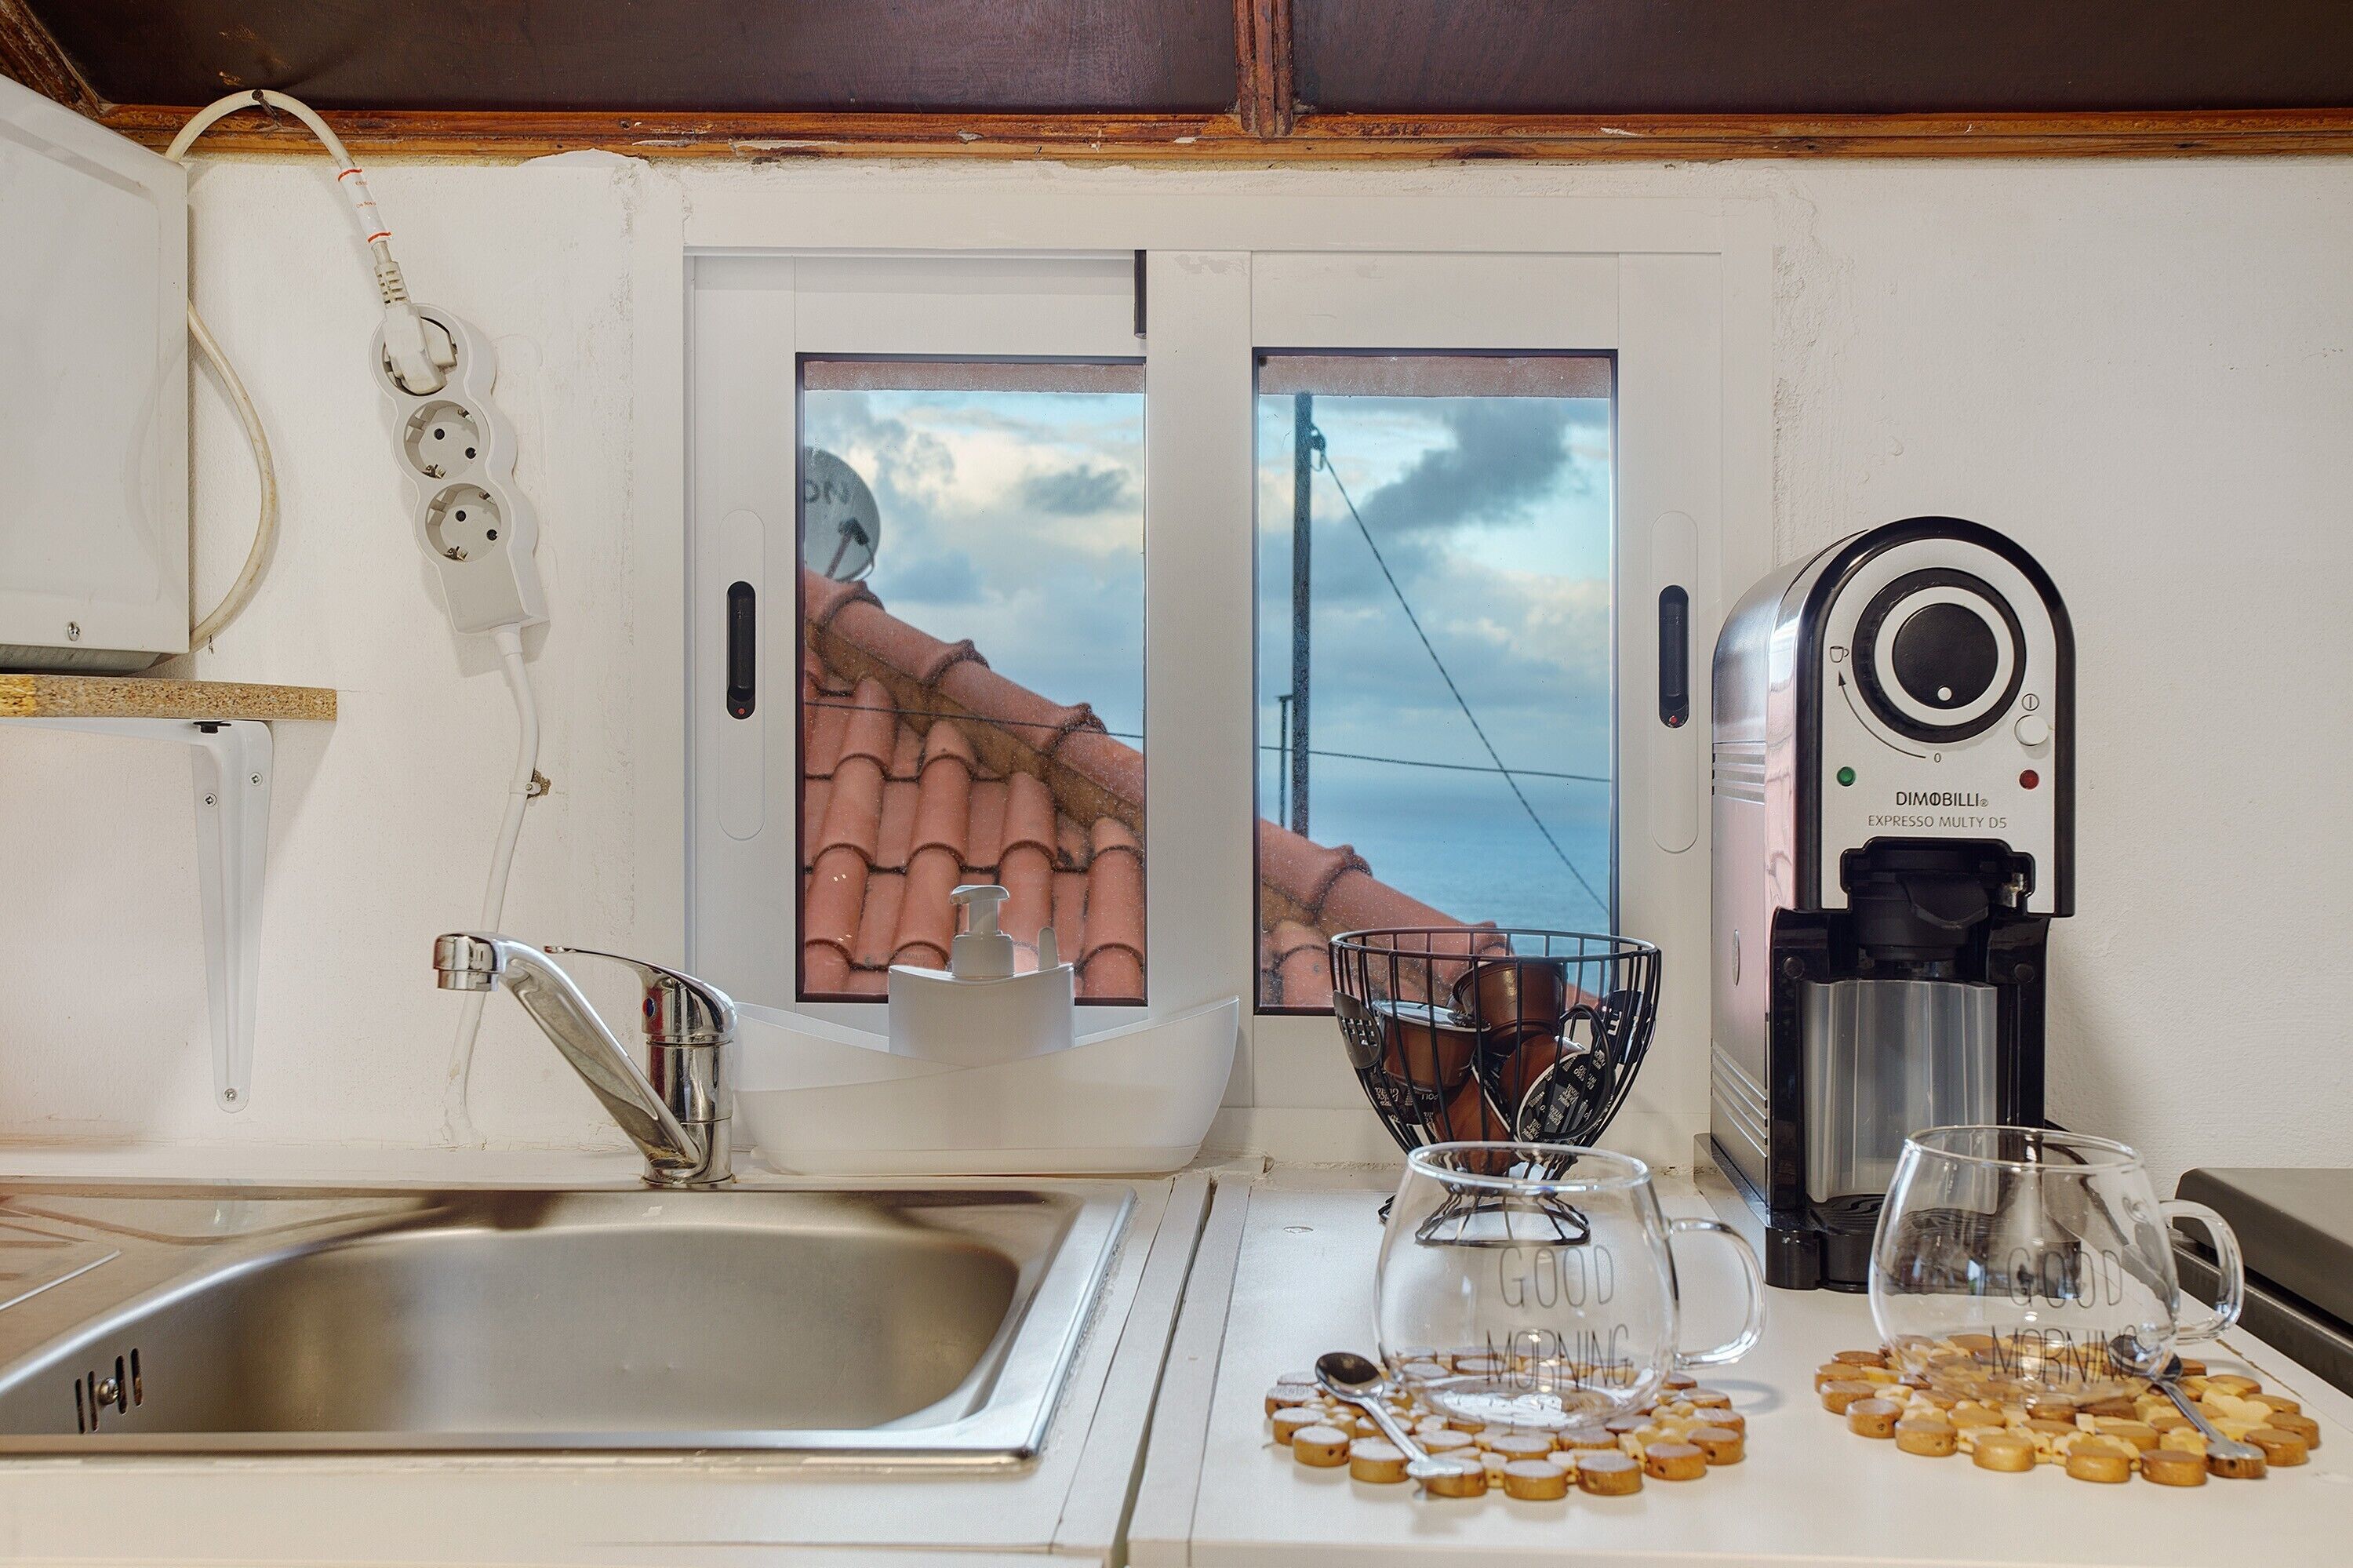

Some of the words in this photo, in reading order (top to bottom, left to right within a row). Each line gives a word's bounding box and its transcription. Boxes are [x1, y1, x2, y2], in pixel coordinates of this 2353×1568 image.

[1868, 814, 1934, 828] EXPRESSO
[1939, 816, 1984, 828] MULTY
[1499, 1245, 1614, 1309] GOOD
[2007, 1247, 2123, 1308] GOOD
[1486, 1323, 1634, 1392] MORNING
